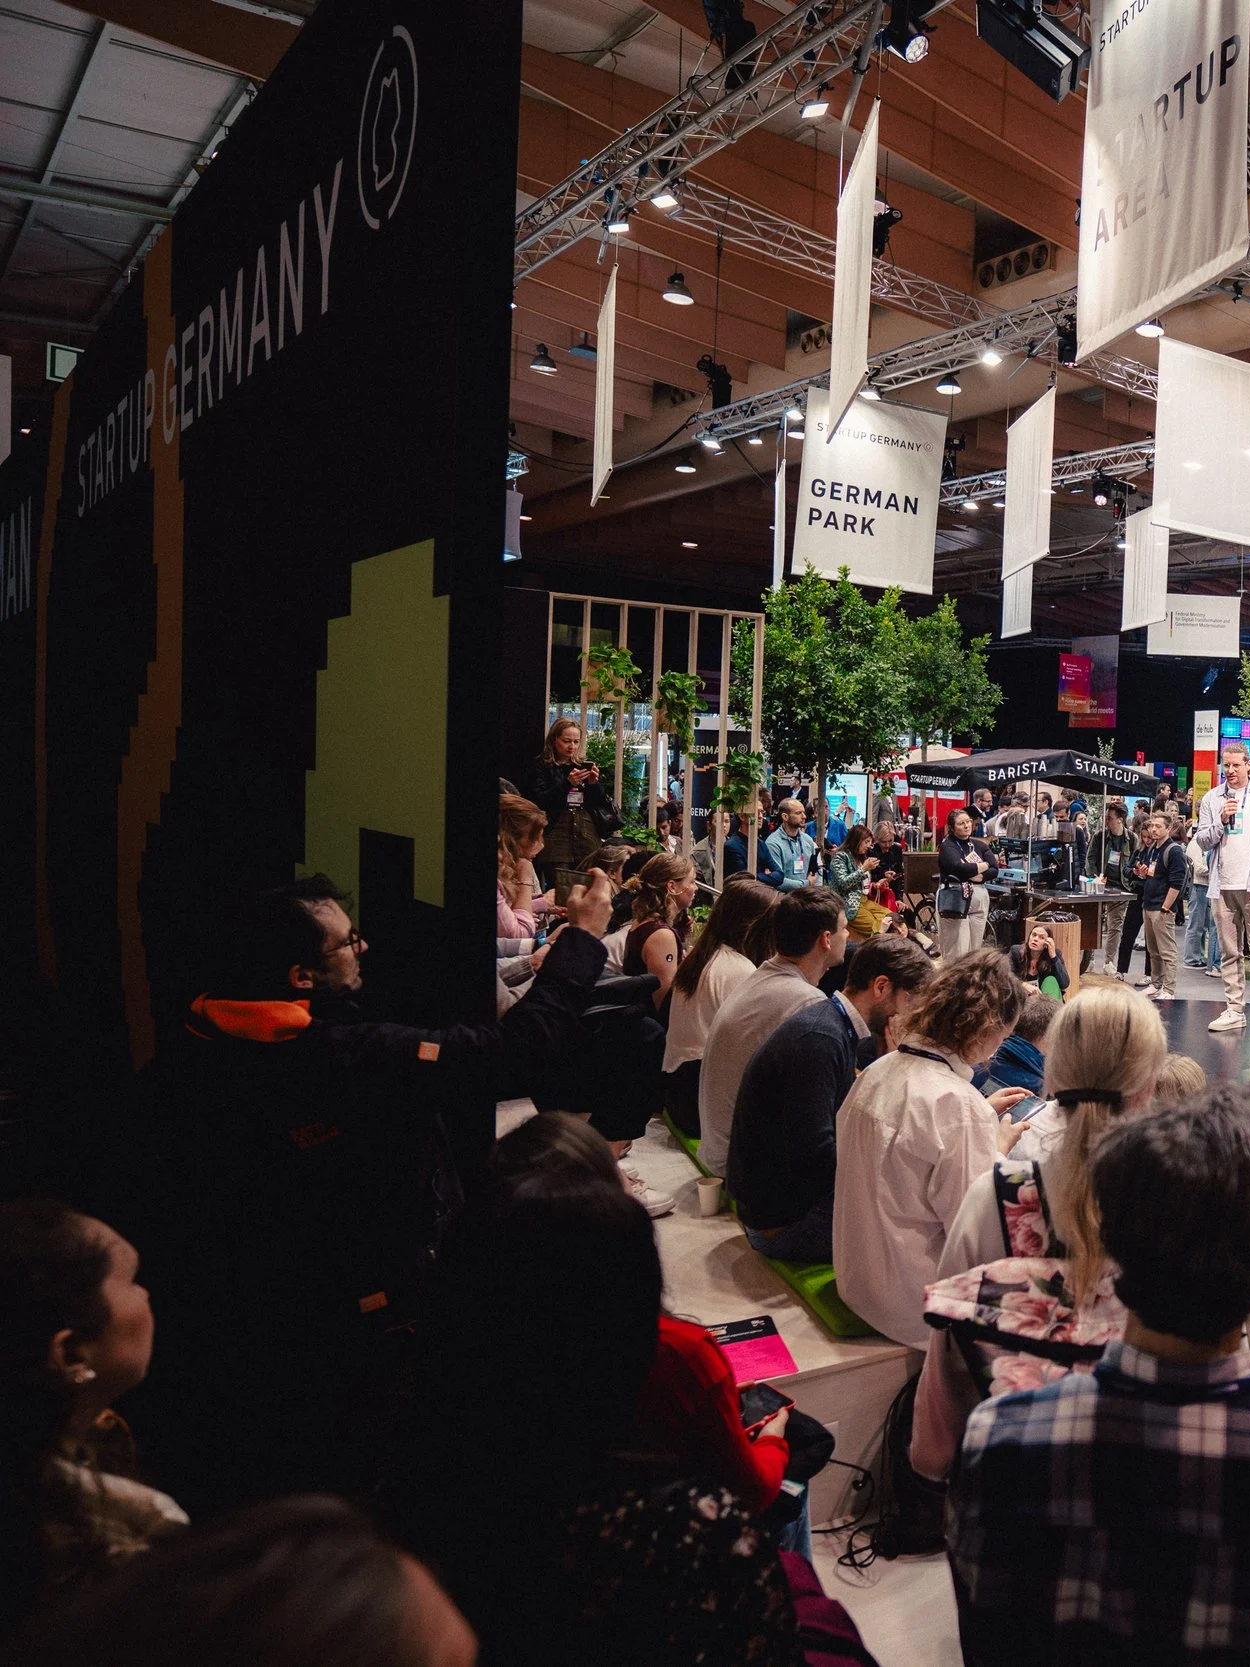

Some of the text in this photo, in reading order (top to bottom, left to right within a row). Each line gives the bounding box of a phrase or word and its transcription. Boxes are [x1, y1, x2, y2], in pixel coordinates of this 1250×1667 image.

[1100, 0, 1149, 52] STARTU
[1095, 160, 1170, 252] AREA
[78, 158, 343, 518] STARTUP GERMANY
[869, 433, 922, 452] GERMANY
[810, 478, 919, 516] GERMAN
[808, 507, 876, 537] PARK
[692, 744, 736, 755] GERMAY
[910, 774, 932, 785] STARTUP
[988, 759, 1140, 785] BARISTA STARTCUP
